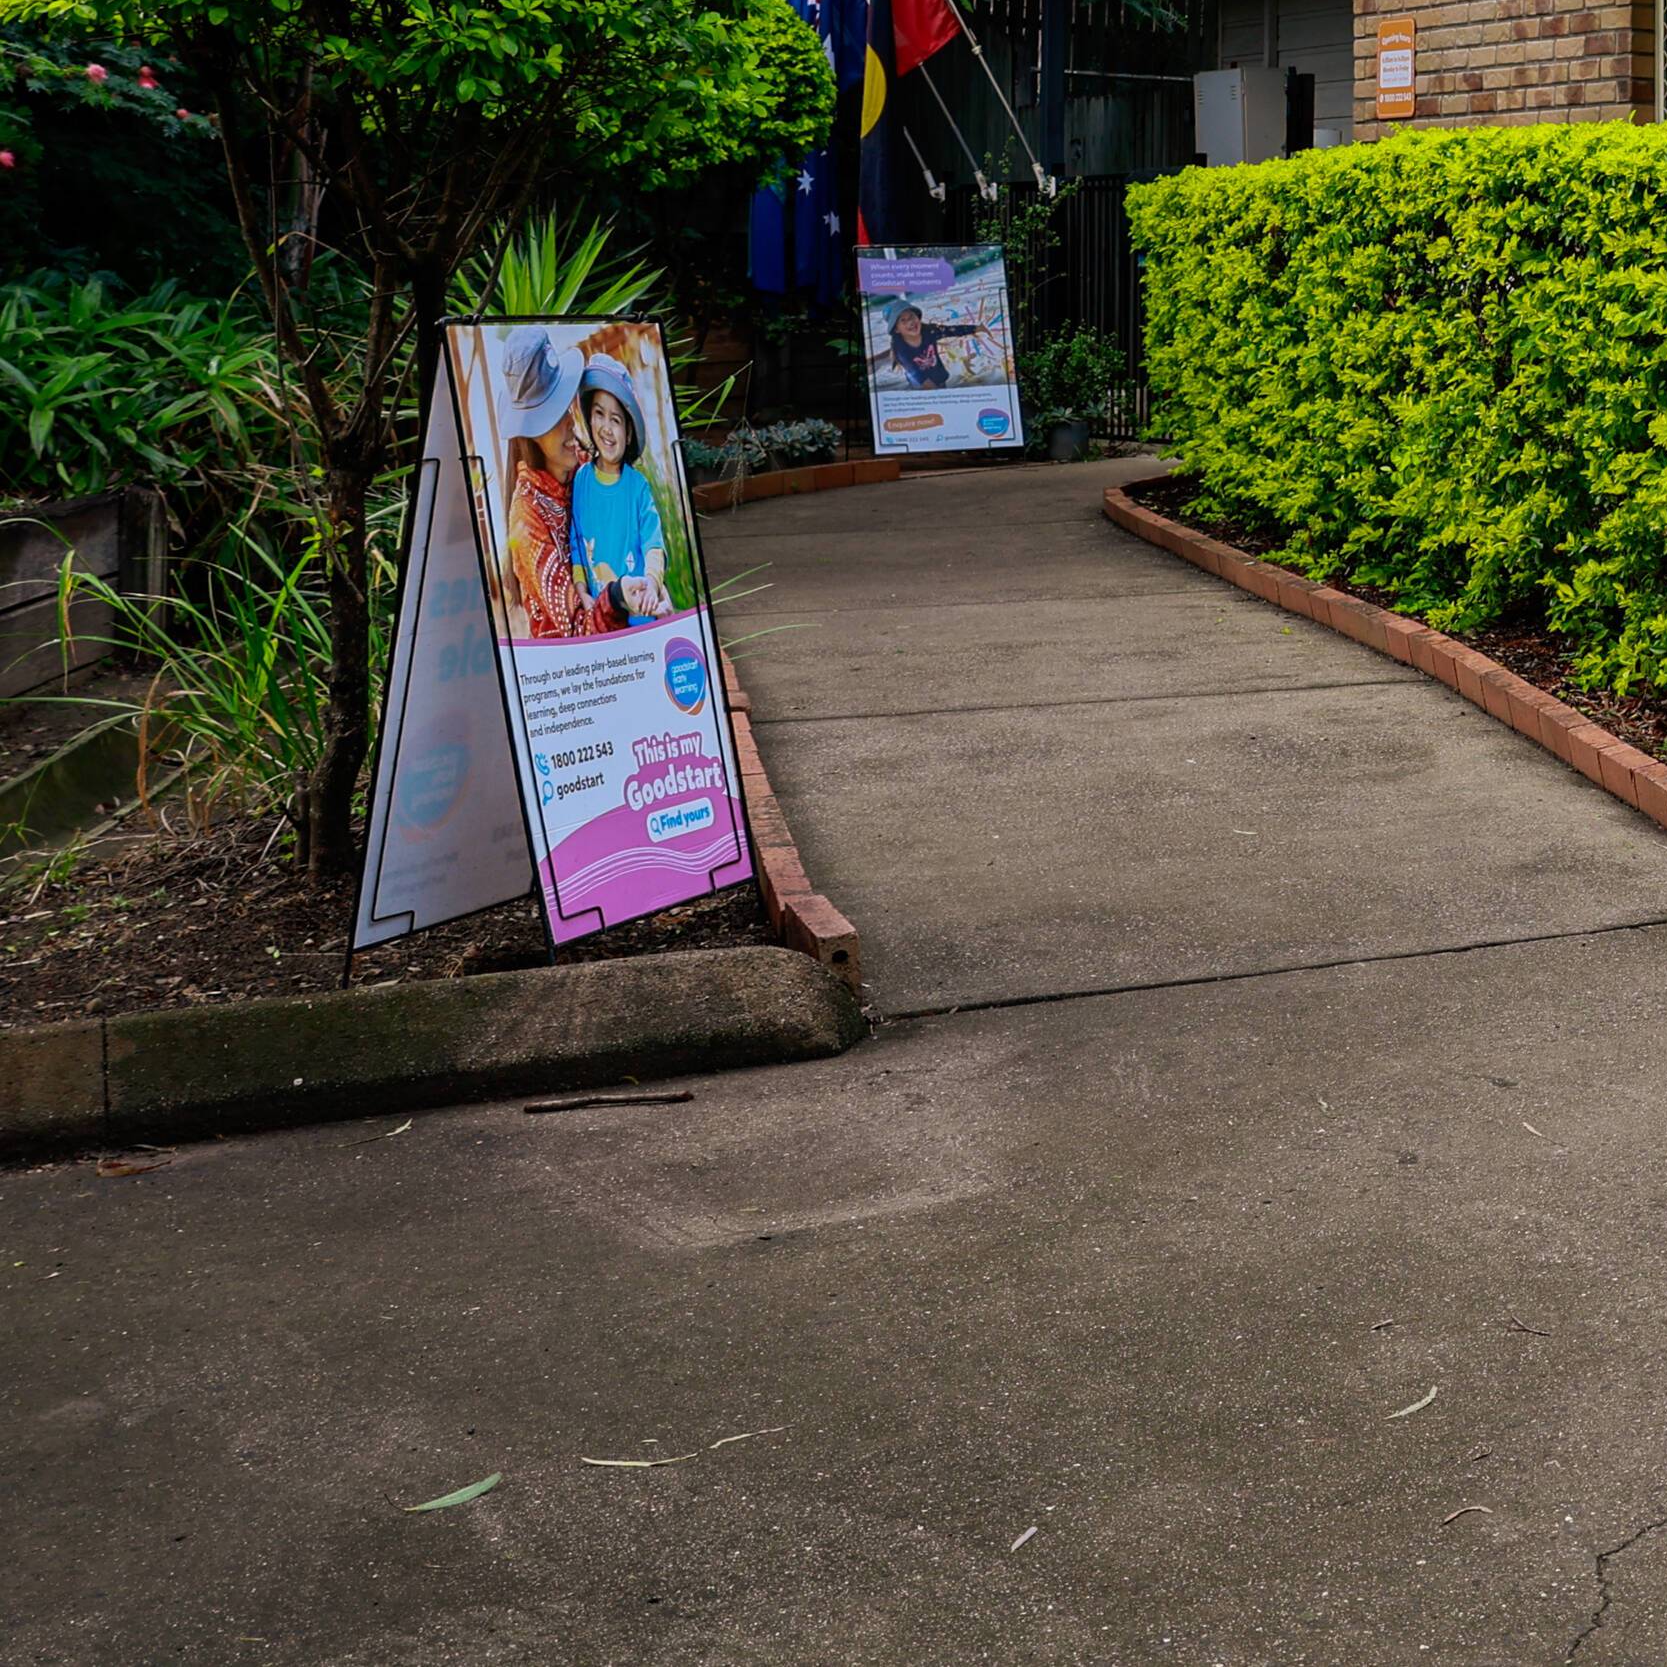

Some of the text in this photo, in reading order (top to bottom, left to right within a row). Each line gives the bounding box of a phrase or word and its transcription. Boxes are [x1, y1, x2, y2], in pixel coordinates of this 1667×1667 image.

[520, 651, 655, 687] Through our leading play-based learning
[523, 669, 645, 707] programs, we lay the foundations for
[526, 693, 617, 722] learning, deep connections
[529, 716, 595, 738] and independence.
[550, 741, 615, 770] 1800 222 543
[634, 734, 701, 766] This is my
[556, 771, 606, 800] goodstart
[626, 762, 723, 811] Goodstart
[660, 805, 711, 831] Find yours
